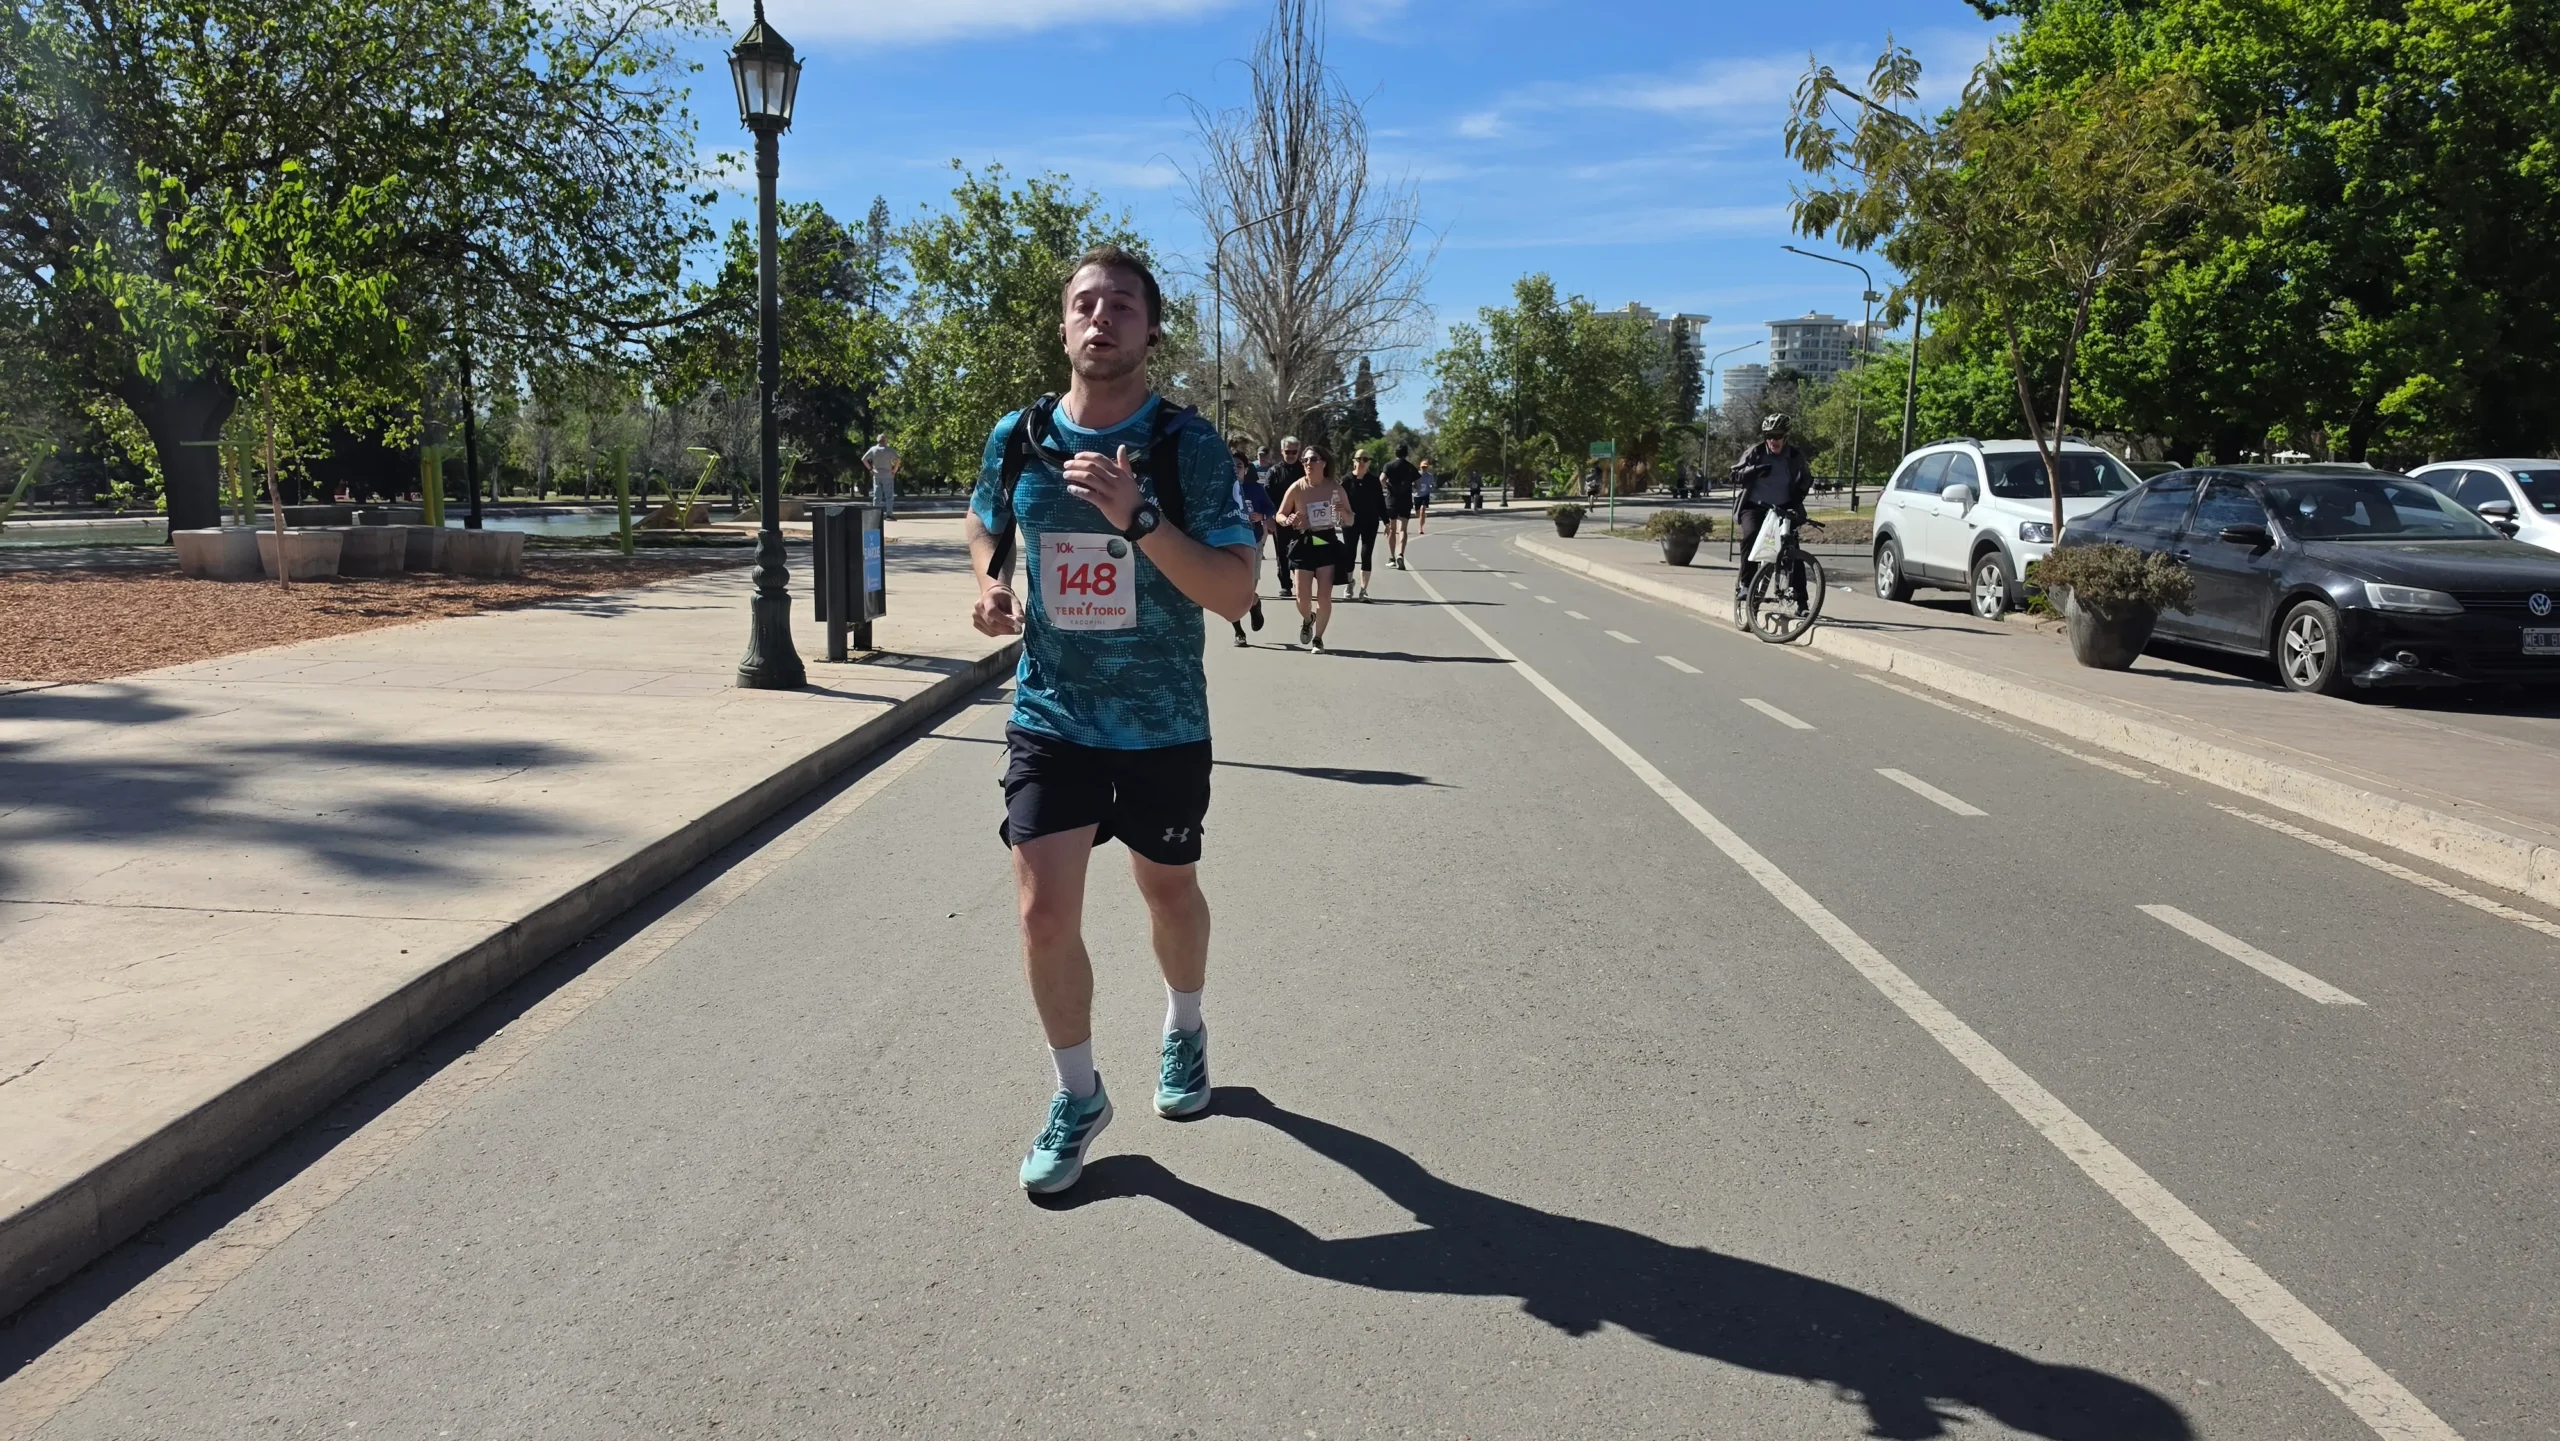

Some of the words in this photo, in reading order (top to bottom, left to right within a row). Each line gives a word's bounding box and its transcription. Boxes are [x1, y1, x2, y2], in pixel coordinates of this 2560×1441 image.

[1313, 508, 1326, 518] 176
[1056, 542, 1074, 554] 10k
[1057, 562, 1116, 596] 148
[1055, 602, 1126, 616] TERRITORIO
[2551, 634, 2560, 646] 8
